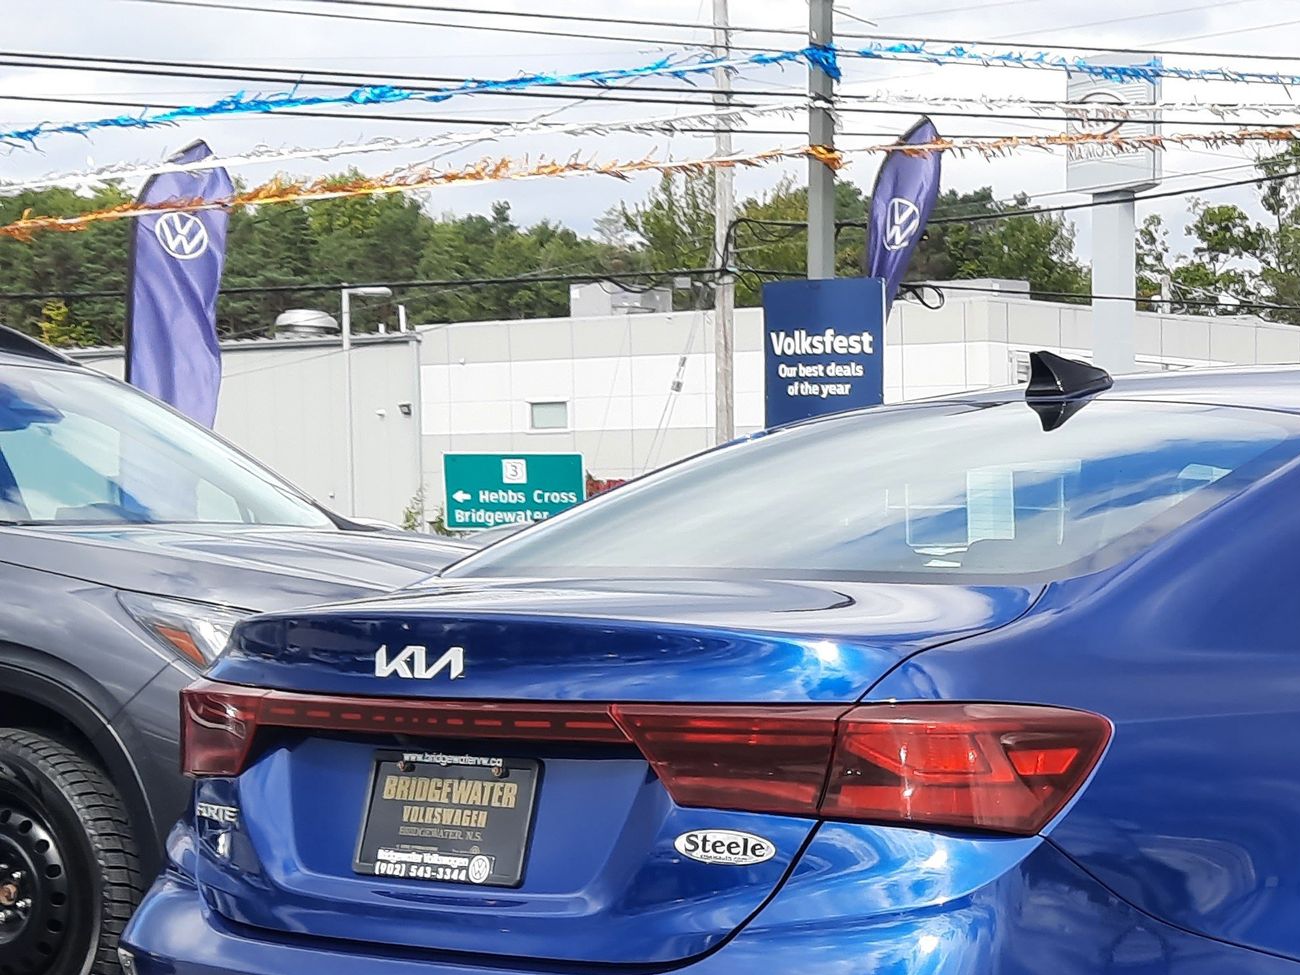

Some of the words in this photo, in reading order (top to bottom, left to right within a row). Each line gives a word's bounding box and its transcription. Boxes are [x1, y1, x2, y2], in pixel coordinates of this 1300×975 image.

[154, 211, 209, 260] VW
[770, 328, 874, 356] Volksfest
[778, 363, 797, 378] Our
[798, 362, 825, 377] best
[826, 362, 864, 377] deals
[787, 381, 801, 396] of
[800, 381, 820, 396] the
[819, 383, 852, 398] year
[510, 464, 518, 477] 3
[478, 490, 526, 504] Hebbs
[532, 490, 577, 503] Cross
[454, 508, 550, 526] Bridgewater
[374, 644, 465, 680] KIA
[382, 774, 518, 809] BRIDGEWATER
[402, 805, 488, 829] VOLKSWAGEN
[465, 830, 484, 842] N.S.
[684, 833, 766, 858] Steele
[374, 860, 406, 876] (902)
[408, 864, 467, 881] 543-3344
